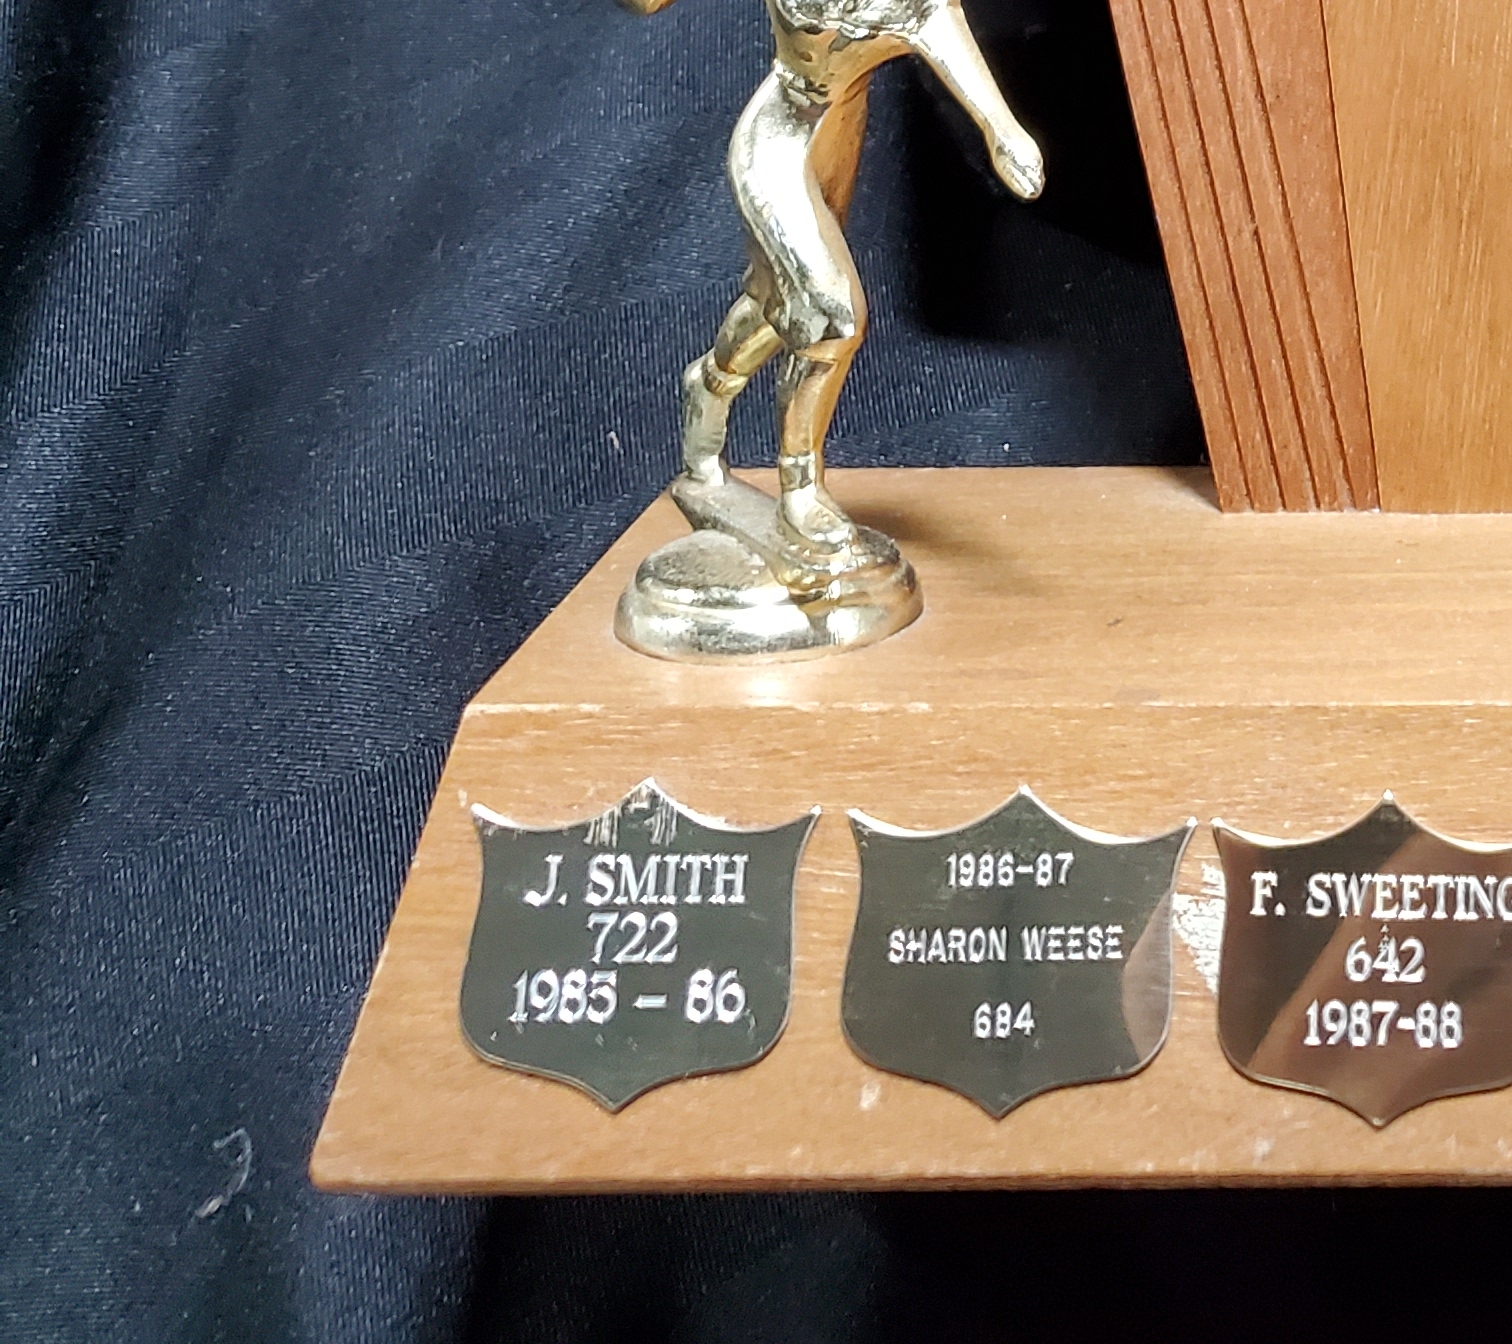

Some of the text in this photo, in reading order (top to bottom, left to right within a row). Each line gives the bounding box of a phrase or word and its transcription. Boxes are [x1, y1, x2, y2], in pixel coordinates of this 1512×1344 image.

[524, 853, 750, 907] J. SMITH
[946, 852, 1074, 887] 1986-87
[1250, 870, 1286, 916] F.
[586, 911, 679, 964] 722
[888, 924, 1124, 964] SHARON WEESE
[1345, 936, 1426, 983] 642
[508, 968, 618, 1023] 1985
[685, 968, 747, 1023] 86
[1303, 999, 1463, 1048] 1987-88
